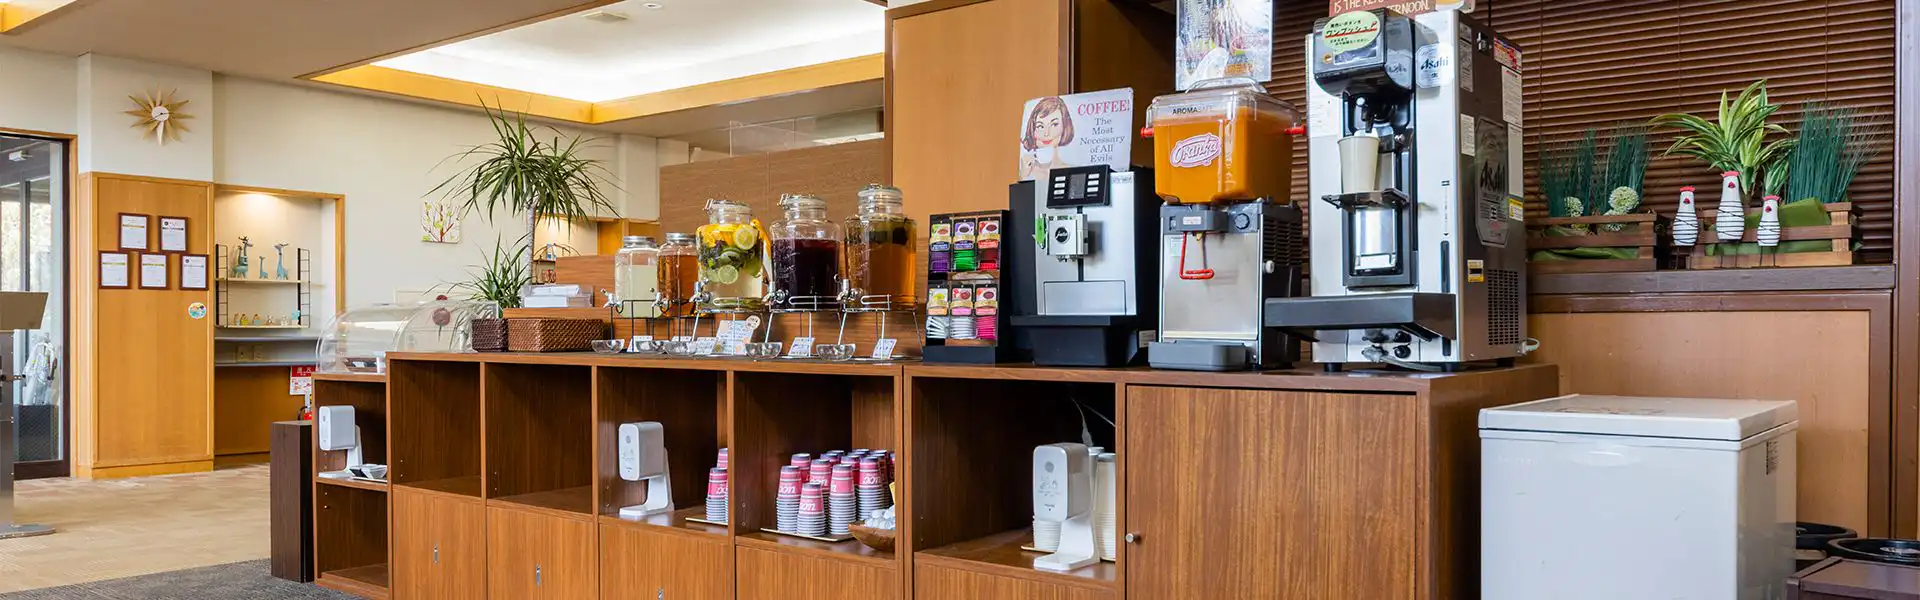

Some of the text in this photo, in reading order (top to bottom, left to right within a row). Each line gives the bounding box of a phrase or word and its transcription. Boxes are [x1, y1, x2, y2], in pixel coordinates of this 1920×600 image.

[1420, 56, 1449, 70] Asahi
[1077, 99, 1130, 116] COFFEE!
[1095, 117, 1112, 126] The
[1092, 126, 1114, 135] Most
[1080, 135, 1126, 145] Necessary
[1090, 144, 1114, 153] of All
[1090, 153, 1113, 162] Evils
